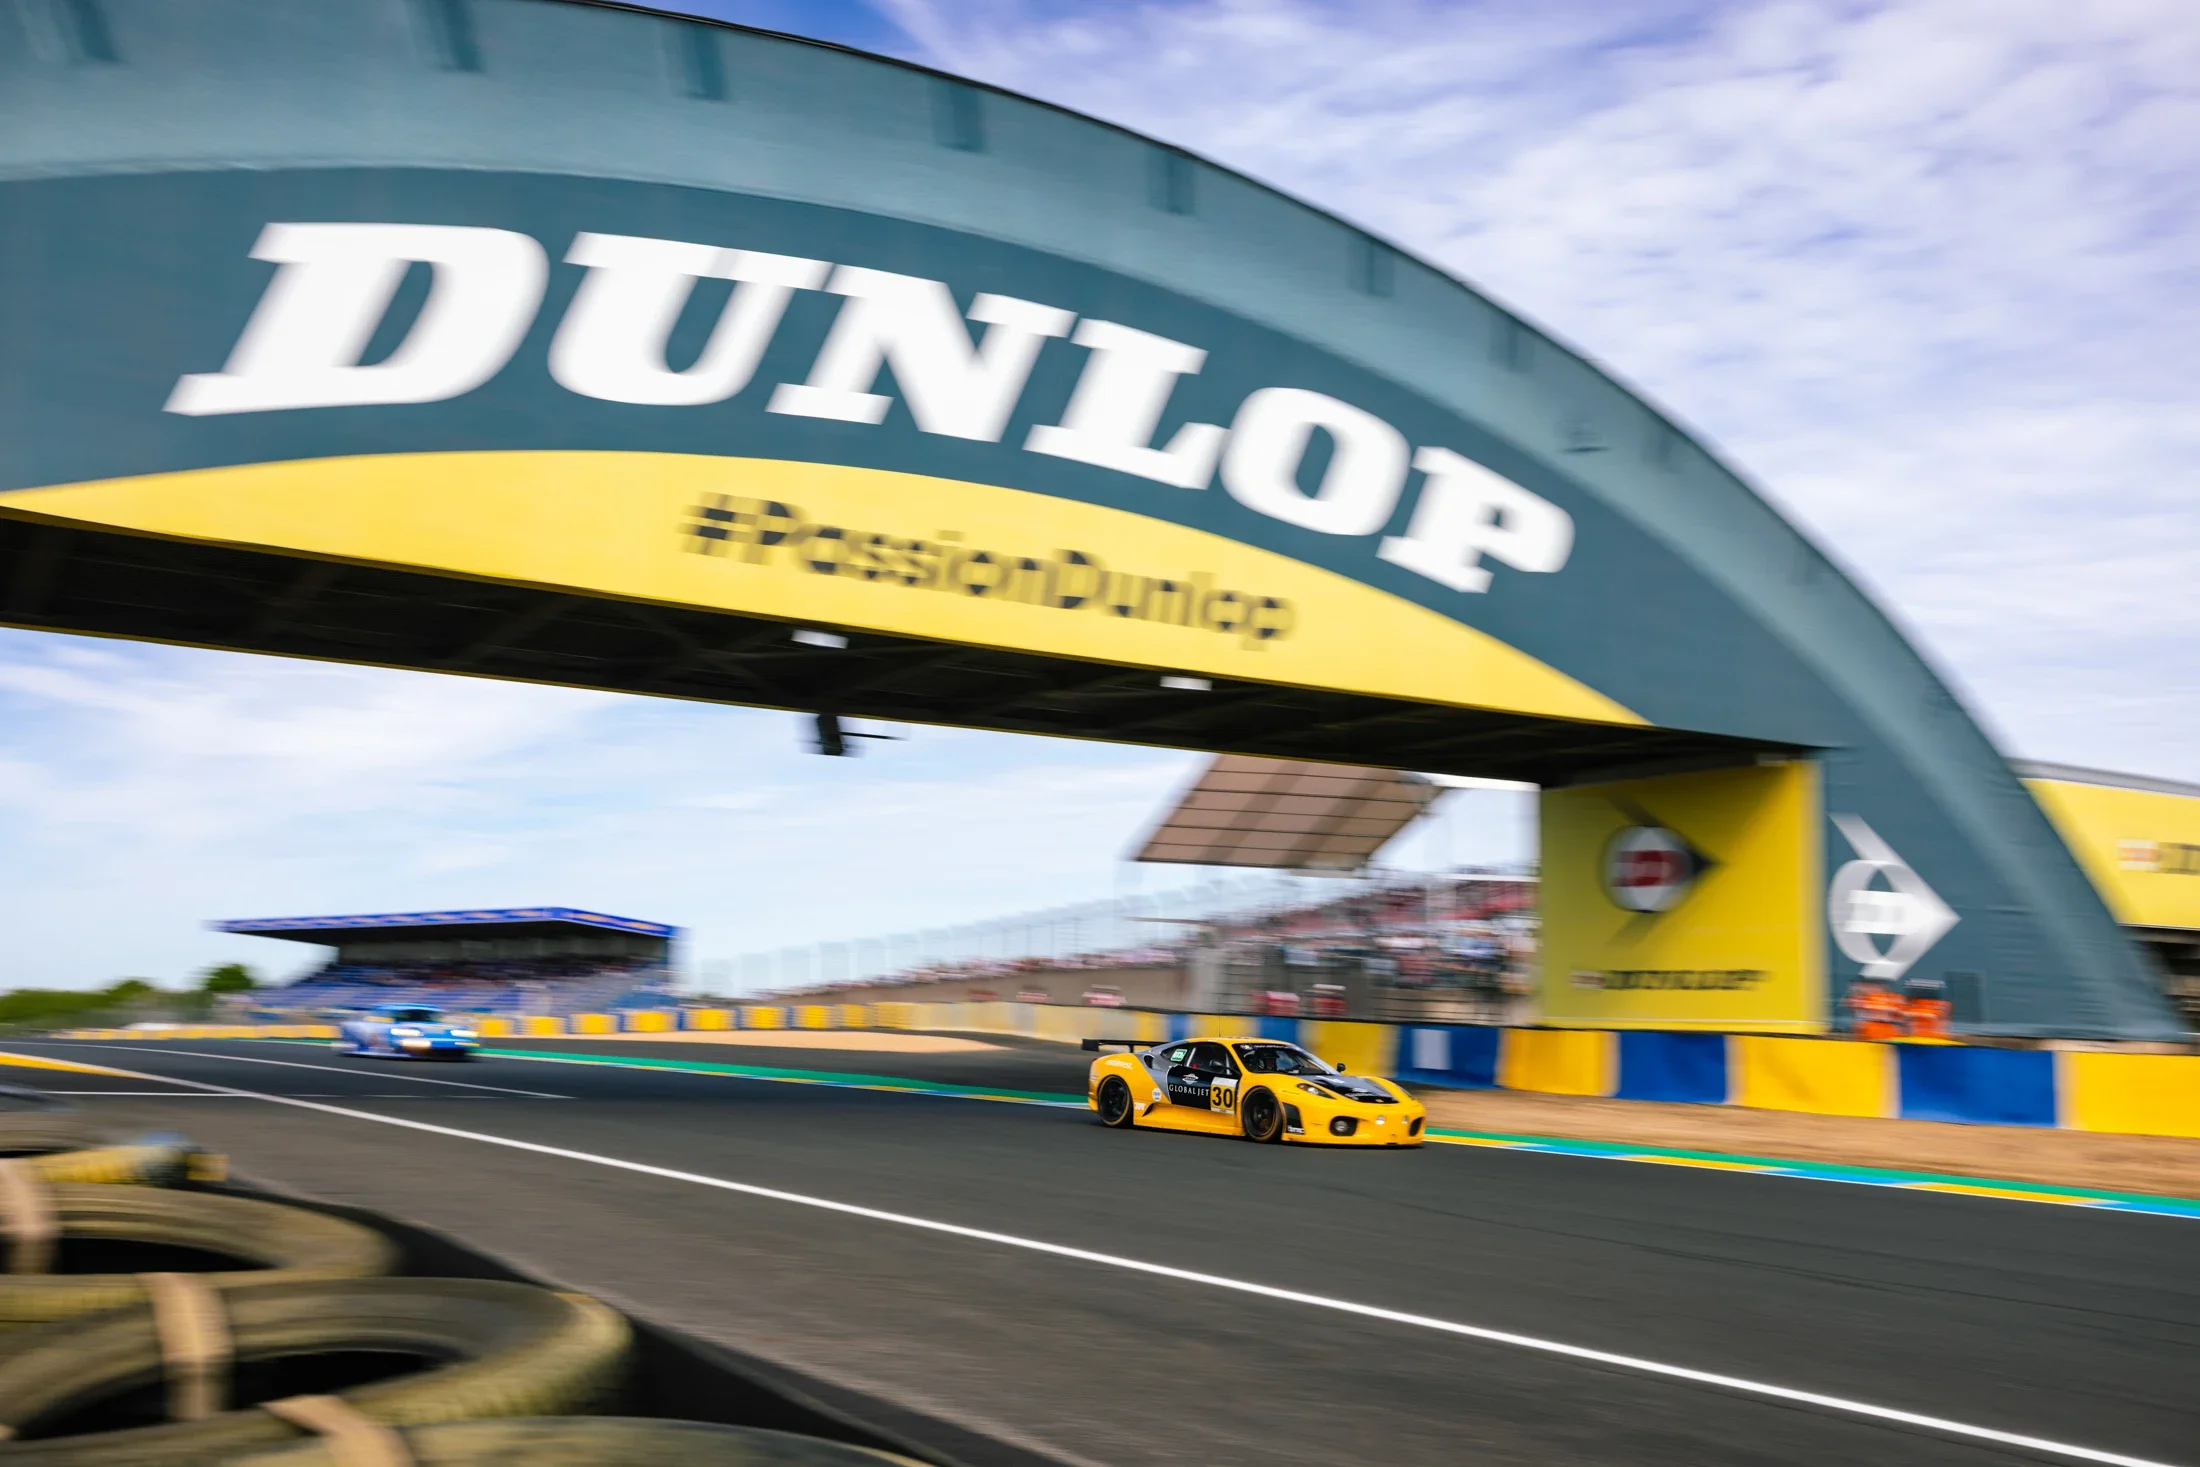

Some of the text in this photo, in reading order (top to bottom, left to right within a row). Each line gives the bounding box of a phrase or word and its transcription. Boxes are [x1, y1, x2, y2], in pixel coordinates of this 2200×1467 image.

[164, 222, 1576, 593] DUNLOP
[680, 491, 1297, 650] #PassionDunlop
[1212, 1086, 1233, 1108] 30
